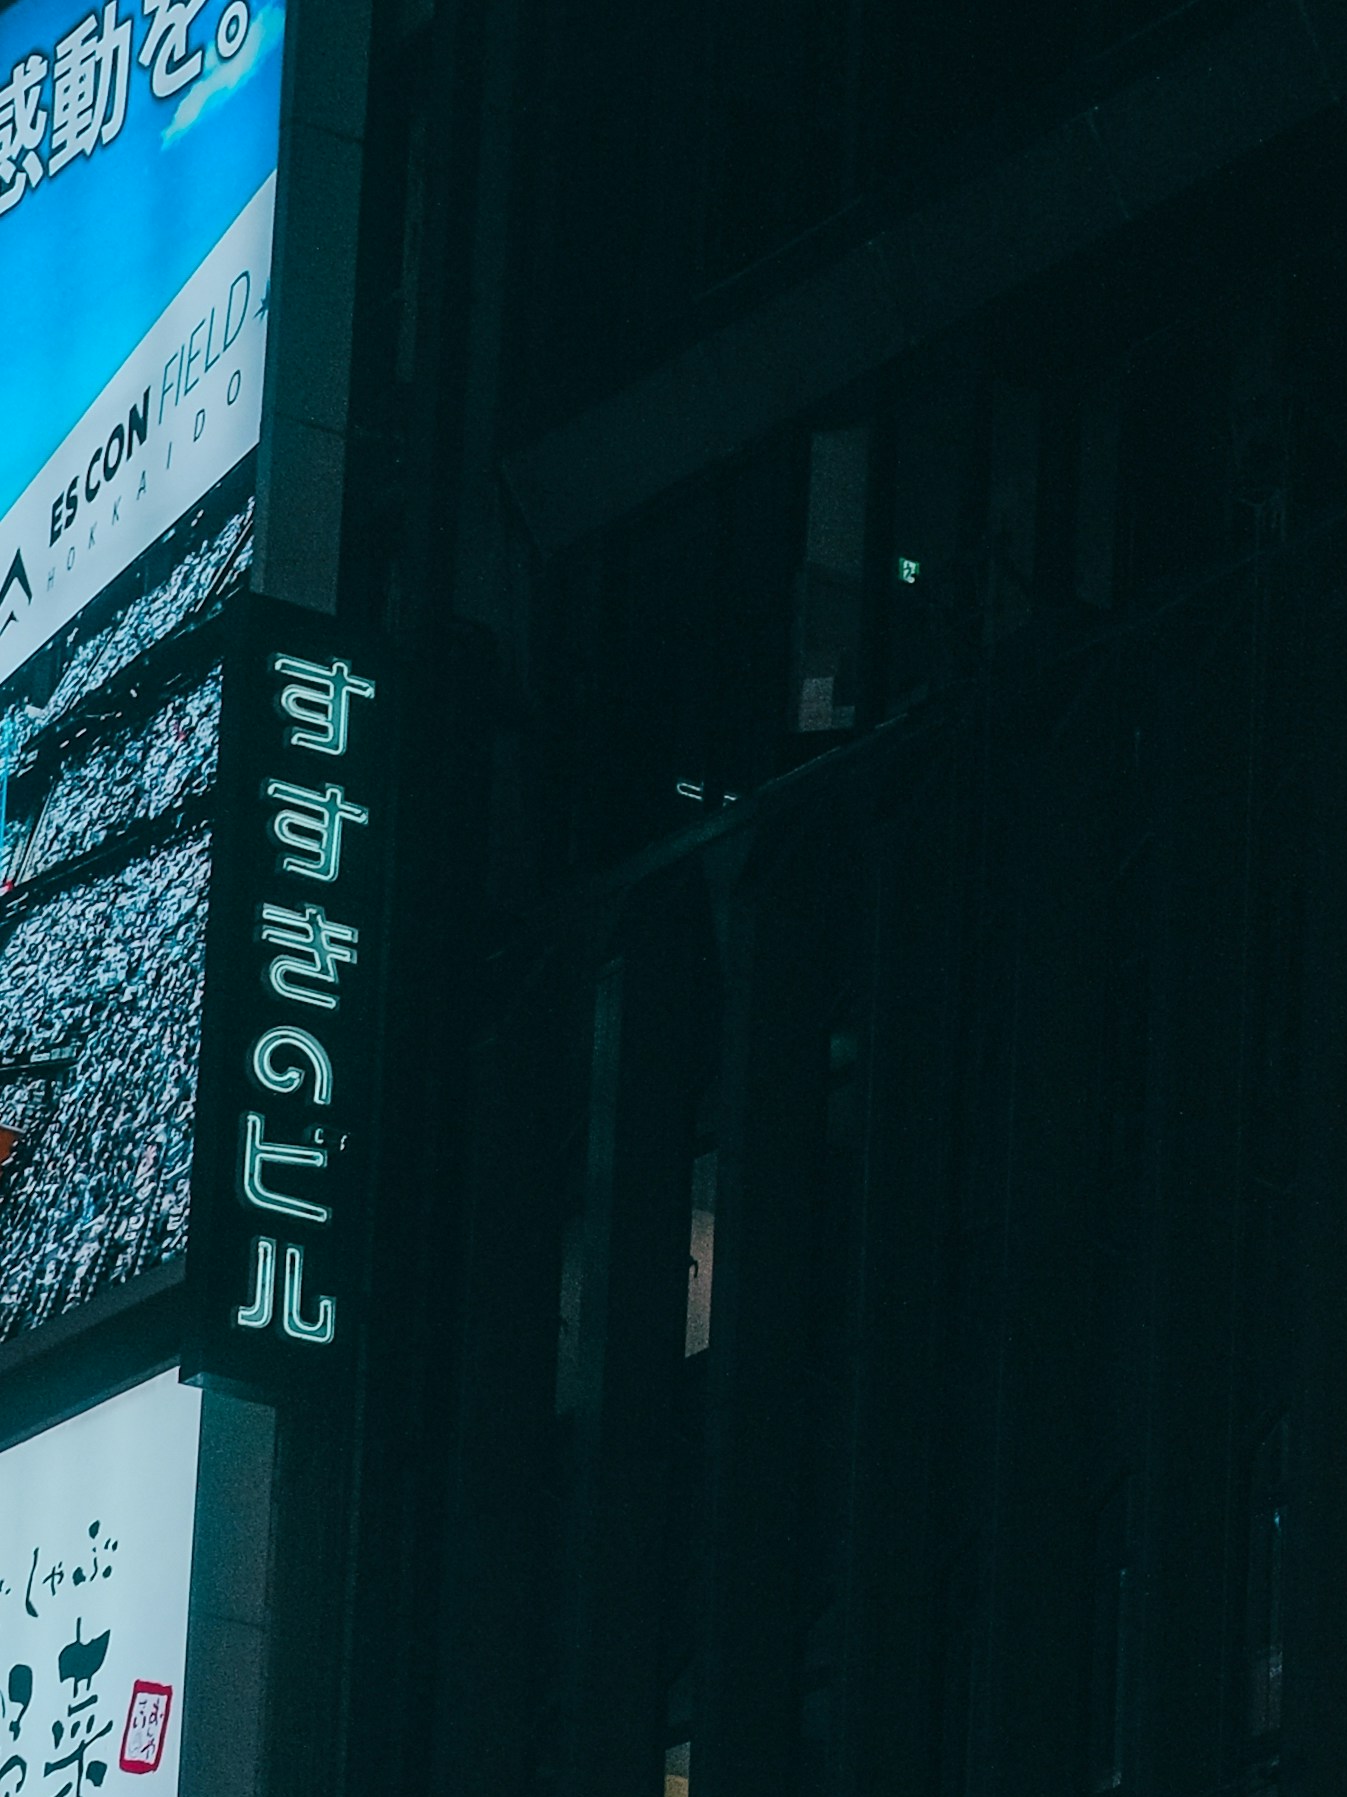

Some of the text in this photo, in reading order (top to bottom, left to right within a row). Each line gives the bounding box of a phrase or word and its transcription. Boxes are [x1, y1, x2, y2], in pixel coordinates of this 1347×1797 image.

[158, 270, 251, 426] FIELD
[47, 369, 242, 592] HOKKAIDO
[239, 652, 376, 1345] すすきのビル
